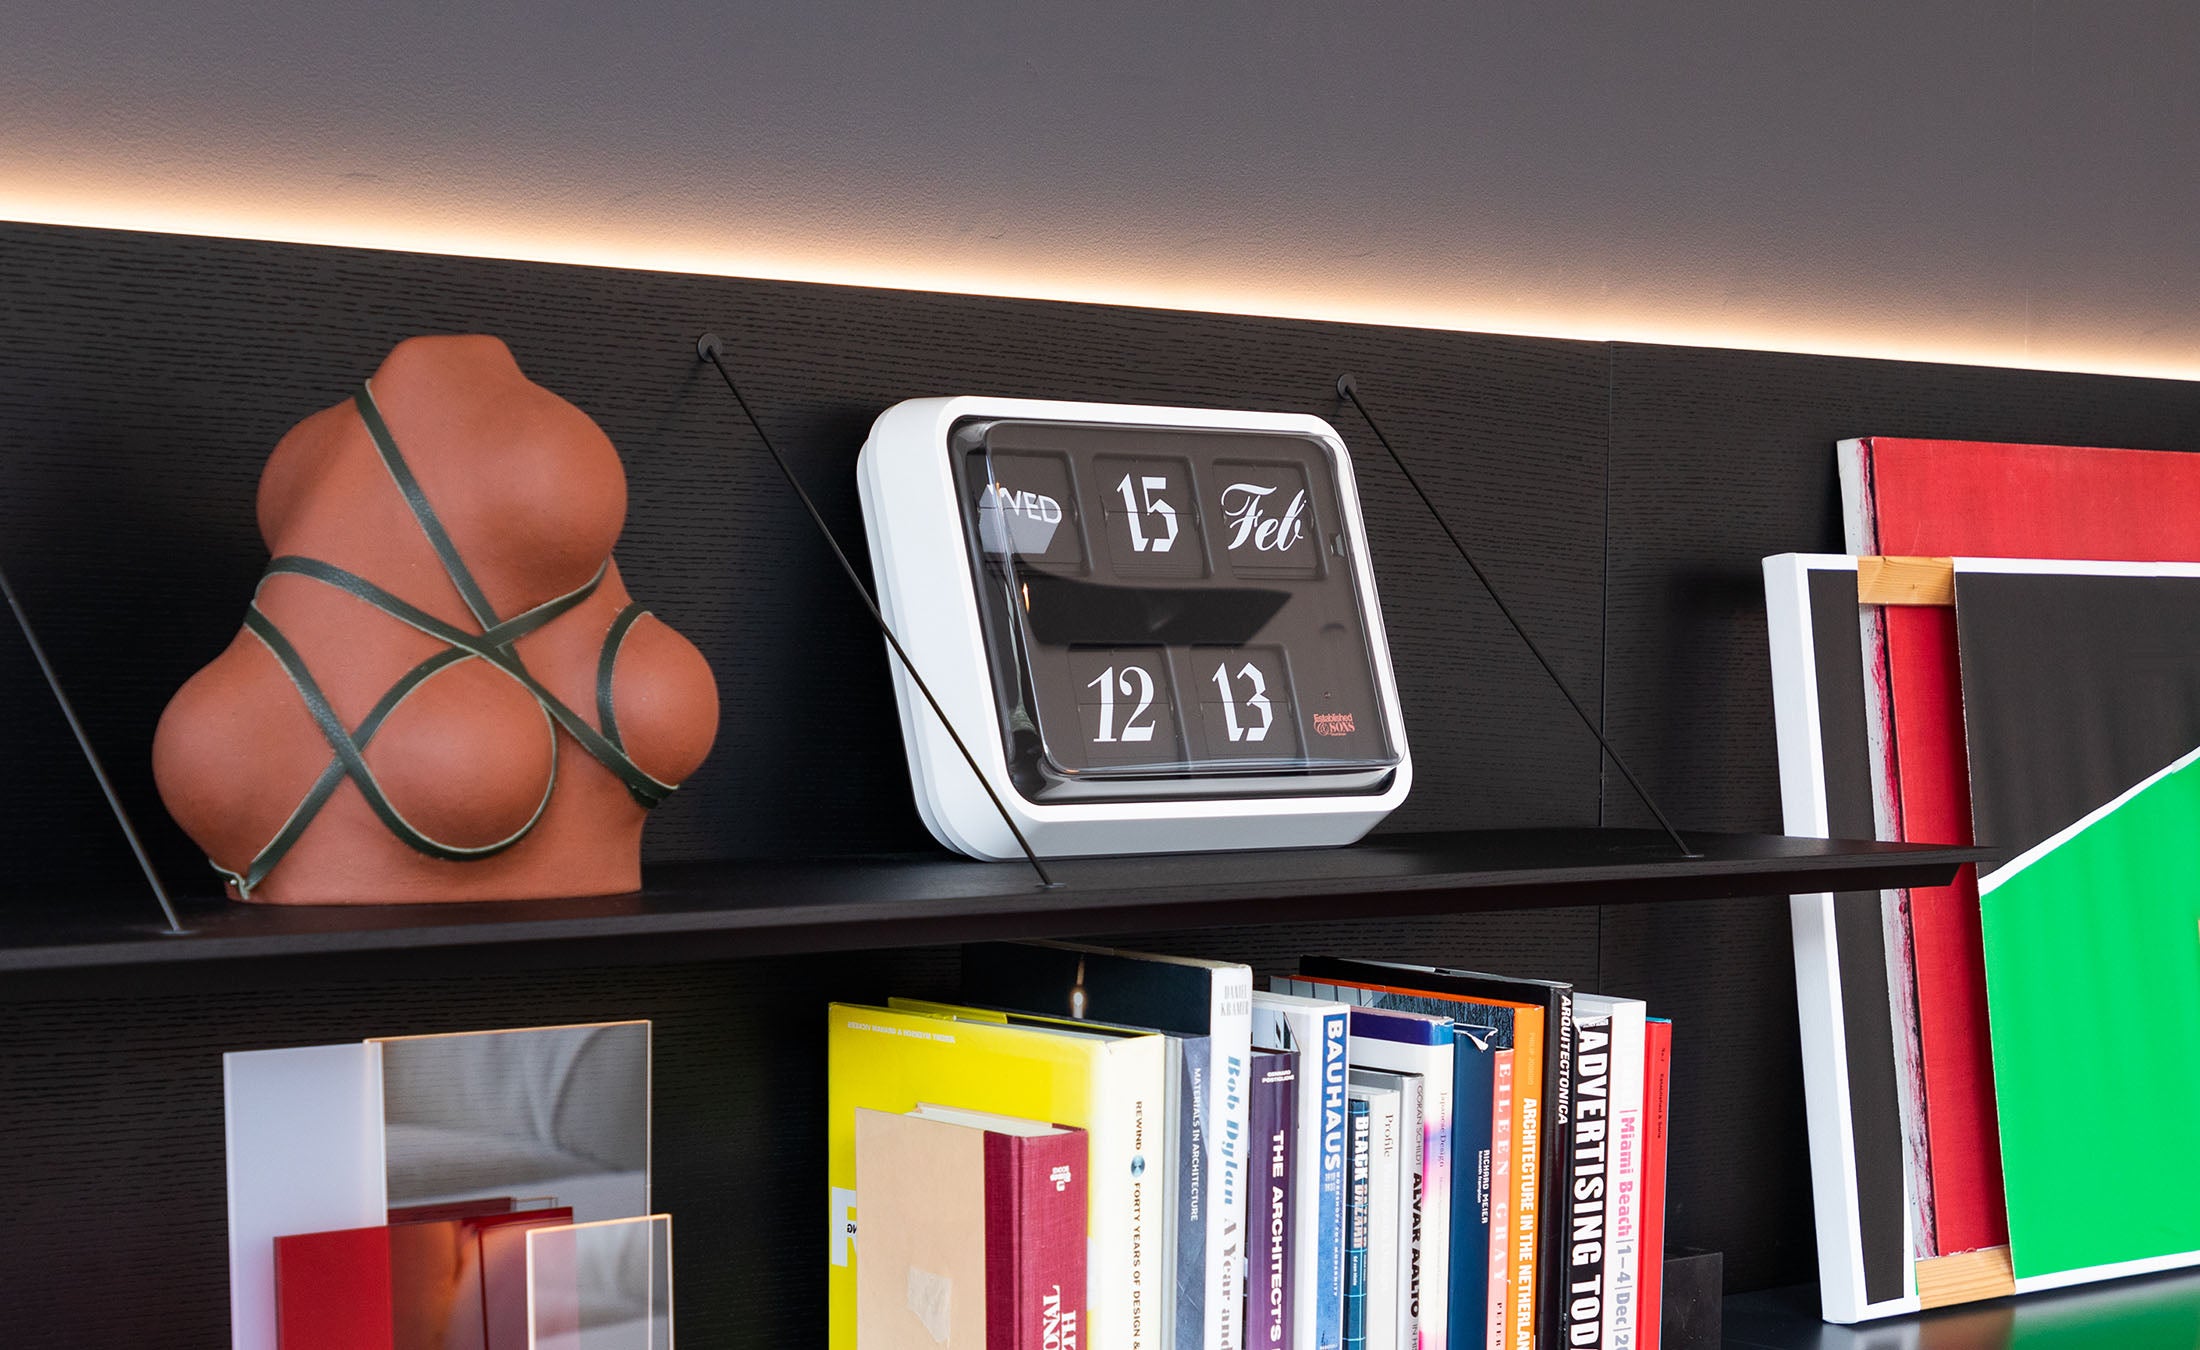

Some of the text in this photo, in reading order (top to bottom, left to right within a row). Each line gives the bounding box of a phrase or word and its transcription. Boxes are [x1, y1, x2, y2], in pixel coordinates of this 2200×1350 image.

[1116, 473, 1178, 552] 15
[1221, 483, 1306, 551] Feb
[1087, 662, 1274, 743] 12 13
[1329, 721, 1356, 733] SONS
[1220, 1001, 1249, 1016] KRAMER
[1227, 1056, 1241, 1110] Bob
[1558, 995, 1571, 1125] ARQUITECTONICA
[1325, 1020, 1343, 1171] BAUHAUS
[1135, 1101, 1143, 1151] REWIND
[1190, 1068, 1202, 1222] MATERIALS IN ARCHITECTURE
[1272, 1130, 1284, 1178] THE
[1354, 1116, 1369, 1182] BLACK
[1383, 1114, 1394, 1158] Profile
[1437, 1135, 1447, 1168] Design
[1520, 1098, 1537, 1211] ARCHITECTURE
[1221, 1120, 1239, 1206] Dylan
[1481, 1149, 1491, 1224] RICHARD MEIER
[1569, 1029, 1608, 1350] ADVERTISING TOD
[1133, 1182, 1141, 1222] FORTY
[1223, 1218, 1237, 1236] A
[1412, 1172, 1423, 1243] ALVAR
[1493, 1064, 1511, 1347] EILEEN GRAY PETER
[1520, 1215, 1534, 1231] IN
[1133, 1226, 1141, 1267] YEARS
[1222, 1244, 1236, 1301] Year
[1270, 1186, 1284, 1342] ARCHITECT'S
[1518, 1233, 1533, 1261] THE
[1133, 1270, 1141, 1286] OF
[1410, 1247, 1421, 1318] AALTO
[1132, 1290, 1141, 1337] DESIGN
